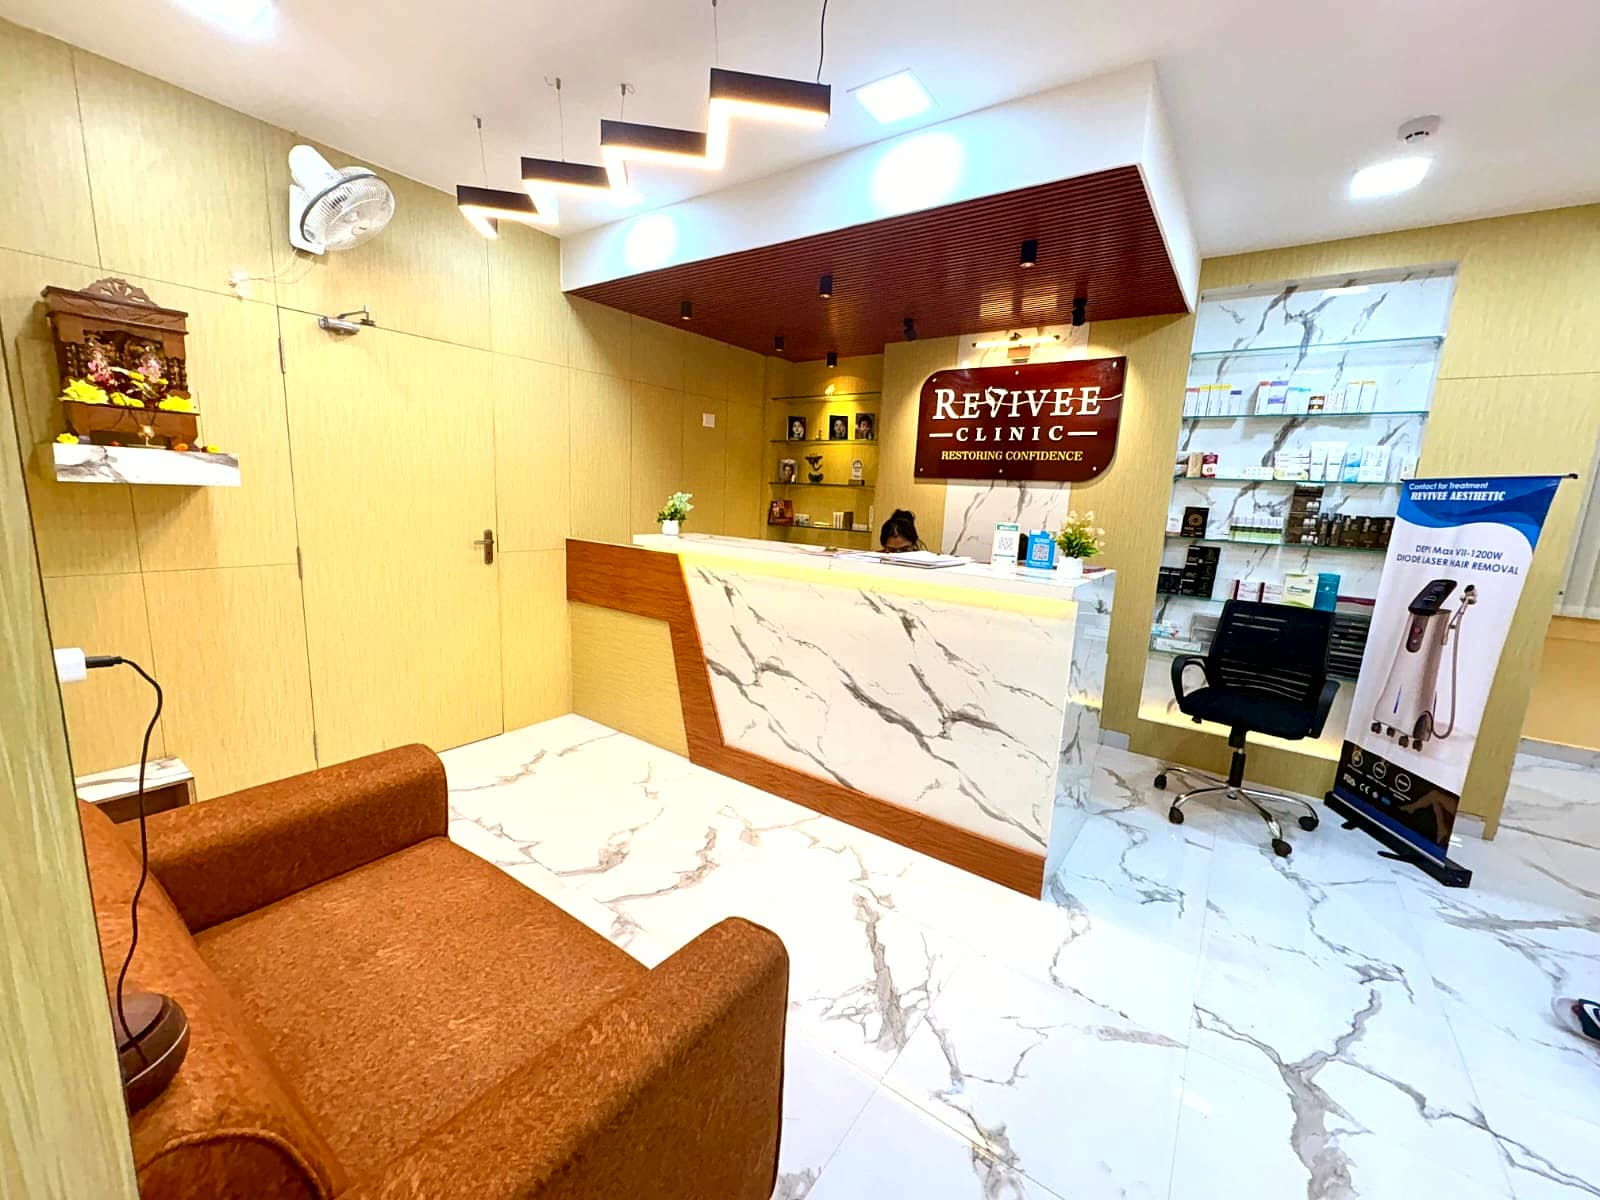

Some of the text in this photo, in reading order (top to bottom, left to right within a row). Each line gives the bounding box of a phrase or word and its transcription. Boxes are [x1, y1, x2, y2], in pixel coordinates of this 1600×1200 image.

[932, 386, 1102, 420] REVIVEE
[956, 425, 1064, 442] CLINIC
[941, 450, 1083, 461] RESTORING CONFIDENCE
[1409, 481, 1489, 490] Contact for Treatment
[1410, 491, 1506, 501] REVIVEE AESTHETIC
[1432, 546, 1454, 556] Max
[1422, 555, 1449, 566] LASER
[1449, 558, 1470, 569] HAIR
[1471, 561, 1519, 575] REMOVAL
